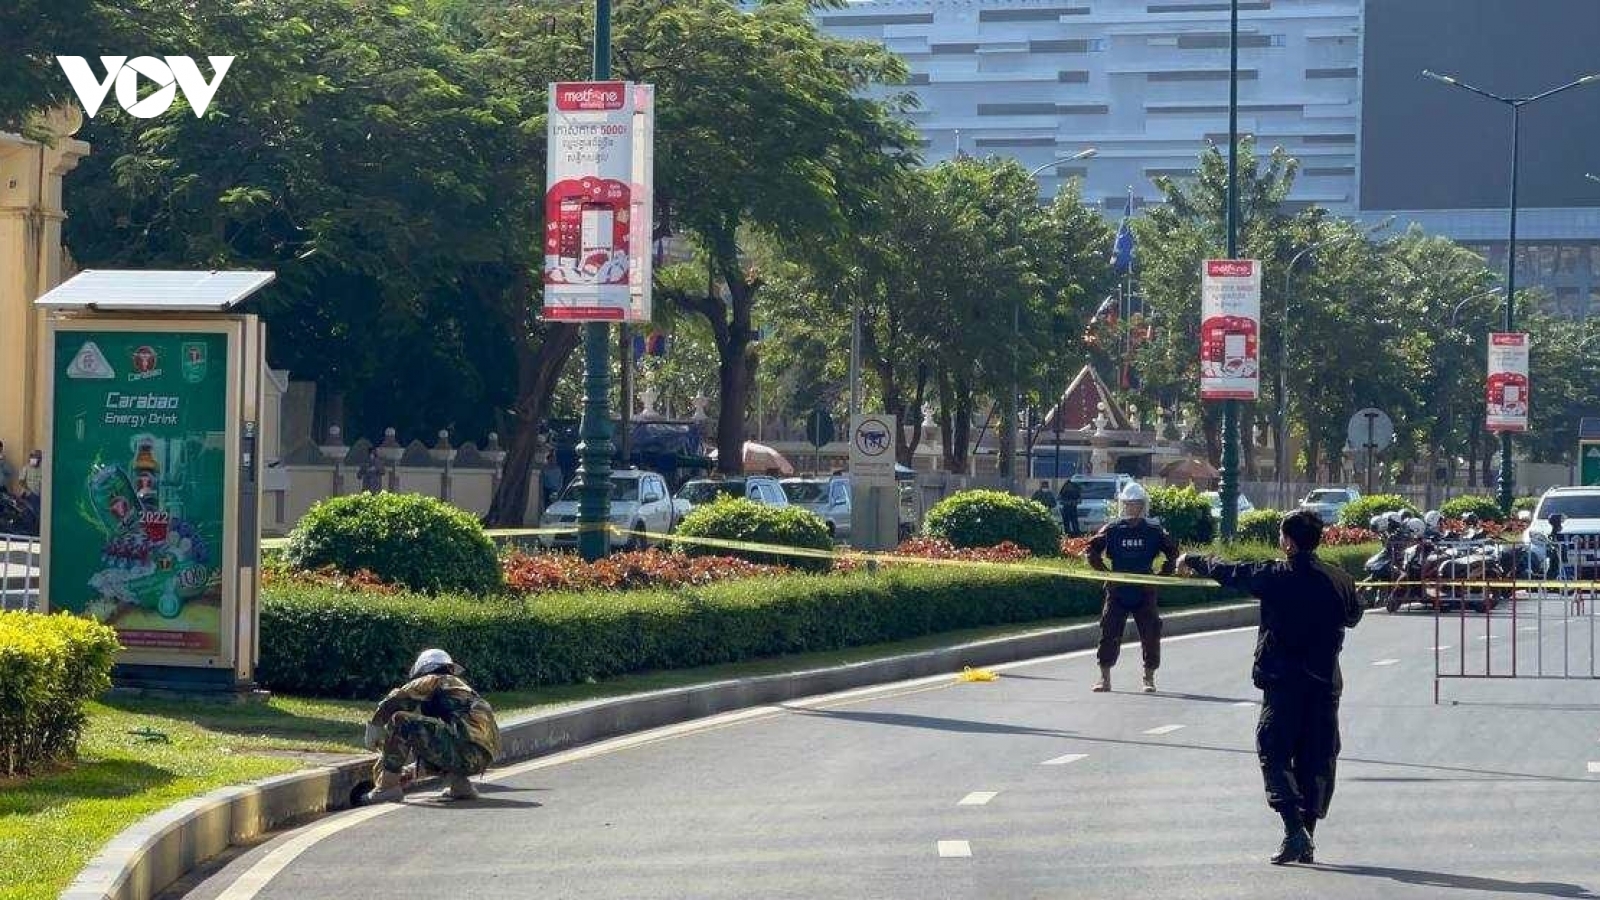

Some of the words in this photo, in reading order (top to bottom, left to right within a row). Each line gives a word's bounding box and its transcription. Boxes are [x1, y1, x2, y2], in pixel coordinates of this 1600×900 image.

[564, 88, 618, 102] metfone
[106, 391, 180, 409] Carabao
[104, 412, 147, 427] Energy
[149, 412, 178, 425] Drink
[139, 511, 168, 523] 2022
